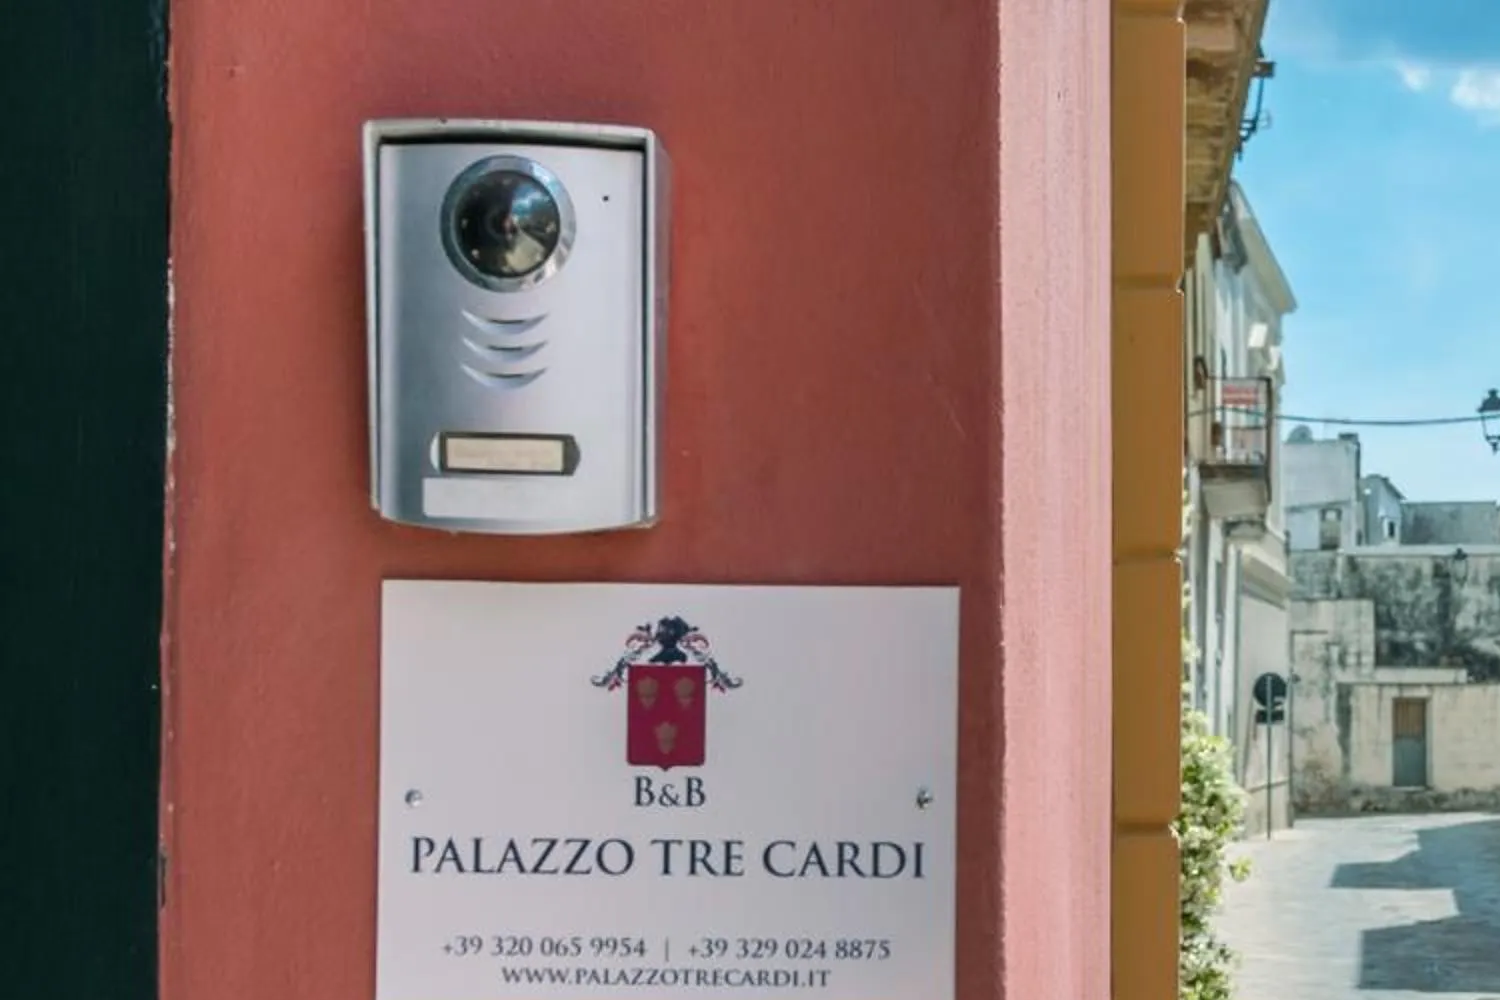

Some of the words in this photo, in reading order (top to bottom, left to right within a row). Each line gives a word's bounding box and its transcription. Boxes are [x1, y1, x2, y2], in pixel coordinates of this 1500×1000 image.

[633, 775, 707, 809] B&B
[410, 836, 636, 877] PALAZZO
[649, 838, 745, 878] TRE
[761, 839, 927, 880] CARDI
[442, 936, 484, 956] +39
[490, 936, 534, 958] 320
[539, 936, 583, 958] 065
[589, 936, 647, 959] 9954
[687, 937, 729, 960] +39
[735, 937, 779, 960] 329
[784, 938, 828, 961] 024
[834, 938, 892, 961] 8875
[500, 966, 832, 989] WWW.PALAZZOTRECARDI.IT
